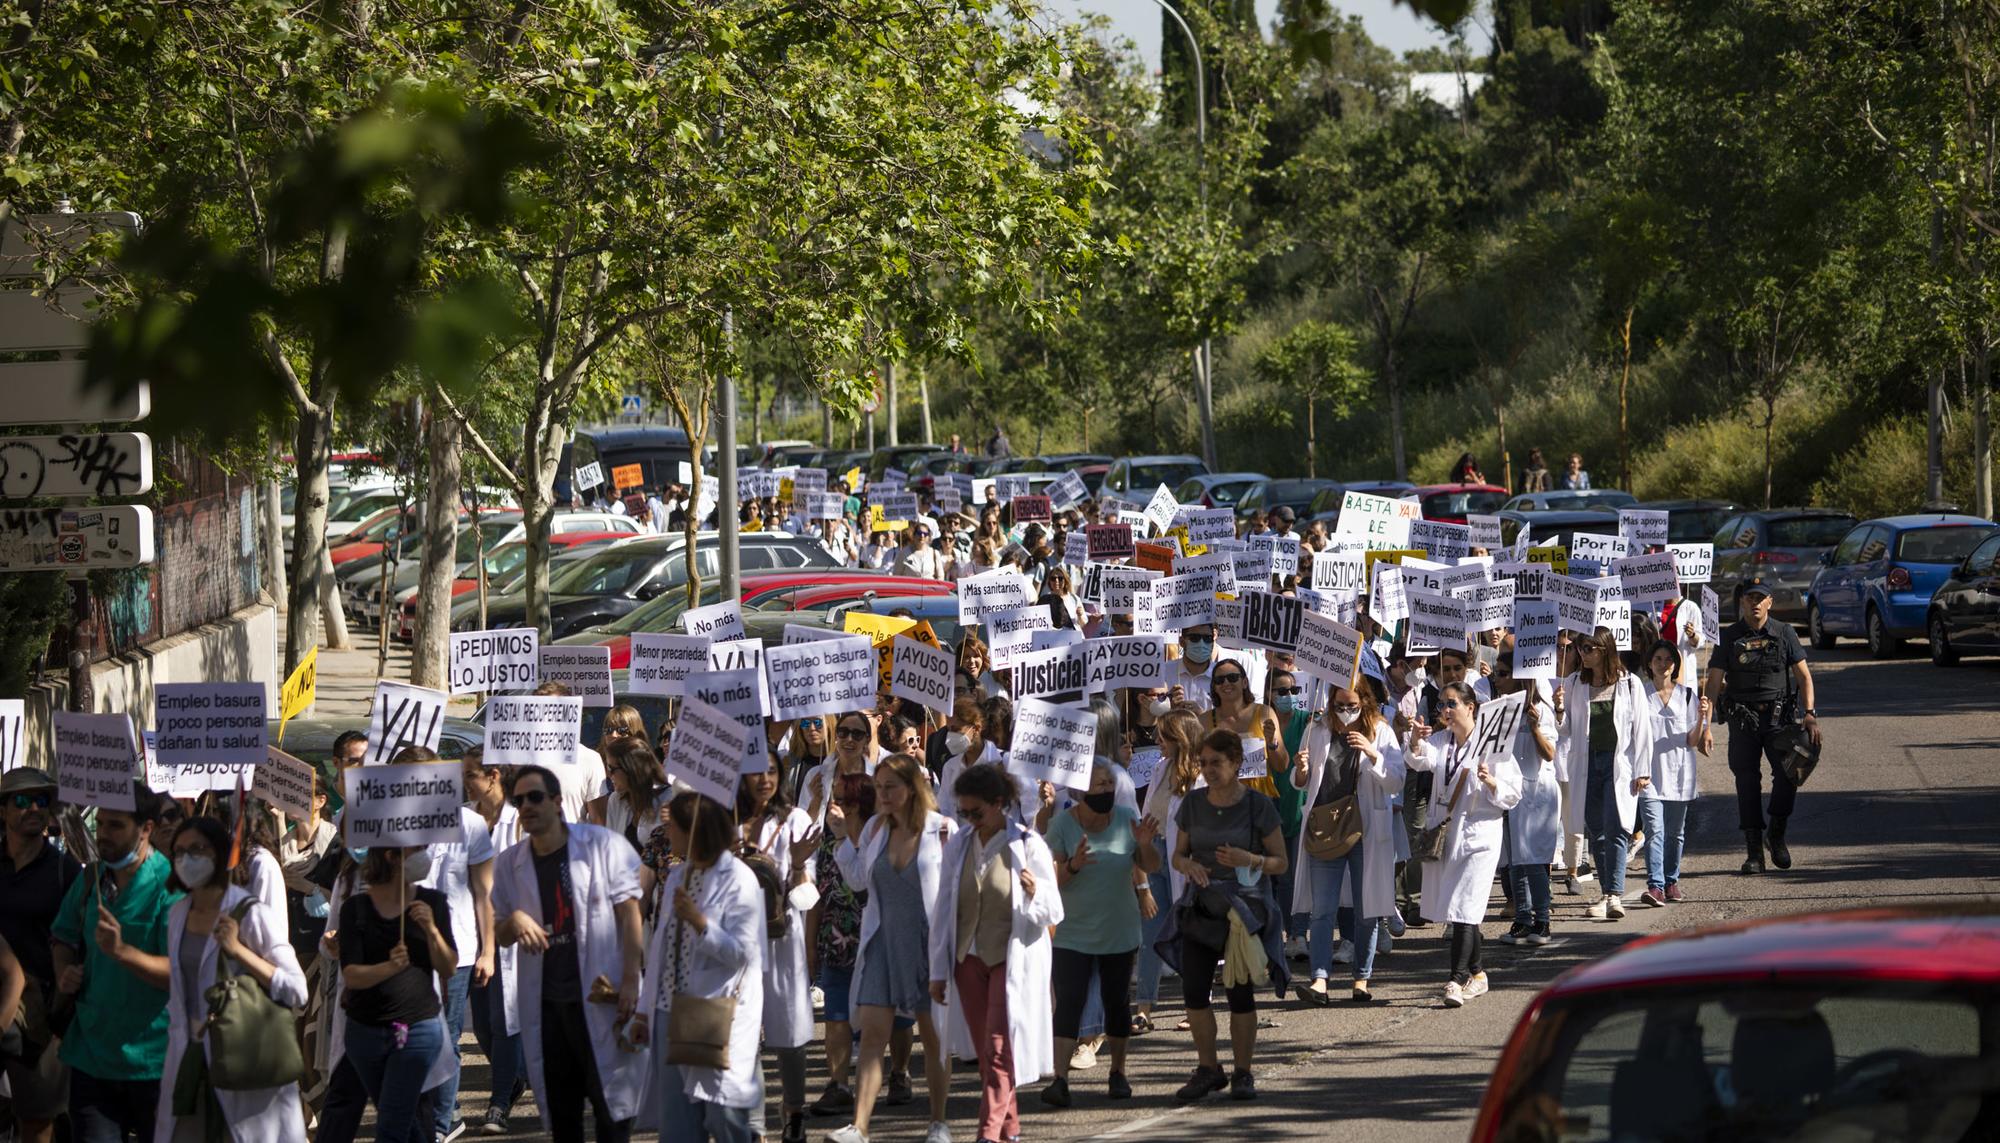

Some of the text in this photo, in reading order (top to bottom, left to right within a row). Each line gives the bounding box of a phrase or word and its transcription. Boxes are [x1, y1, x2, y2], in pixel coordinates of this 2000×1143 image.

[1345, 495, 1392, 515] BASTA
[1207, 516, 1233, 528] apoyos
[1620, 516, 1667, 529] ¡Más apoyos
[1196, 532, 1202, 540] la
[1204, 530, 1235, 539] Sanidad!
[1432, 524, 1469, 542] RECUPEREMOS
[1636, 530, 1667, 539] Sanidad!
[1574, 537, 1626, 552] ¡Por la
[1700, 547, 1711, 559] la
[1637, 560, 1674, 575] sanitarios,
[963, 580, 1022, 600] ¡Más sanitarios,
[1102, 577, 1126, 592] ¡Más
[1175, 576, 1213, 596] RECUPEREMOS
[1424, 574, 1440, 590] la
[1564, 580, 1597, 604] RECUPEREMOS
[1622, 578, 1677, 599] muy necesarios!
[1104, 600, 1110, 608] a
[1112, 598, 1122, 608] la
[1476, 584, 1513, 603] RECUPEREMOS
[715, 611, 735, 628] más
[964, 606, 980, 618] muy
[1155, 604, 1182, 620] NUESTROS
[1184, 599, 1213, 617] DERECHOS!
[1429, 602, 1464, 621] sanitarios,
[1620, 606, 1629, 619] la
[993, 613, 1049, 638] ¡Más sanitarios,
[1520, 611, 1554, 630] ¡No más
[1303, 618, 1357, 650] Empleo basura
[1413, 622, 1465, 640] muy necesarios!
[1518, 634, 1556, 648] contratos
[455, 634, 533, 664] ¡PEDIMOS
[995, 645, 1009, 661] muy
[1088, 641, 1161, 665] ¡AYUSO,
[1305, 636, 1322, 653] poco
[543, 654, 609, 666] Empleo basura
[661, 646, 709, 664] precariedad,
[772, 654, 821, 674] Empleo
[824, 648, 868, 665] basura
[896, 646, 951, 682] ¡AYUSO,
[1297, 647, 1319, 665] dañan
[1320, 657, 1329, 669] tu
[1522, 652, 1552, 669] basura!
[453, 662, 536, 688] LO JUSTO!
[542, 670, 549, 682] y
[551, 670, 573, 682] poco
[635, 664, 658, 683] mejor
[772, 680, 780, 694] y
[784, 675, 815, 694] poco
[818, 666, 873, 685] personal
[1014, 652, 1088, 700] ¡Justicia!
[1091, 663, 1160, 683] ABUSO!
[575, 686, 583, 695] tu
[723, 681, 751, 702] más
[896, 669, 951, 702] ABUSO!
[158, 693, 261, 712] Empleo basura
[777, 683, 873, 709] dañan tu salud.
[493, 703, 578, 723] BASTA! RECUPEREMOS
[1020, 707, 1094, 737] Empleo basura
[156, 714, 265, 733] y poco personal
[682, 705, 714, 735] Empleo
[714, 723, 744, 752] basura
[1471, 702, 1521, 760] YA!
[56, 725, 89, 748] Empleo
[92, 730, 126, 750] basura
[158, 735, 201, 750] dañan
[205, 737, 218, 749] tu
[222, 733, 264, 749] salud.
[490, 731, 576, 752] NUESTROS DERECHOS!
[674, 729, 682, 743] y
[681, 732, 703, 752] poco
[1014, 731, 1094, 756] y poco personal
[64, 752, 85, 768] poco
[670, 747, 696, 772] dañan
[697, 762, 708, 777] tu
[1012, 747, 1088, 775] dañan tu salud.
[277, 759, 312, 784] basura
[60, 771, 131, 795] dañan tu salud.
[272, 785, 280, 799] tu
[356, 773, 457, 808] ¡Más sanitarios,
[354, 806, 460, 839] muy necesarios!
